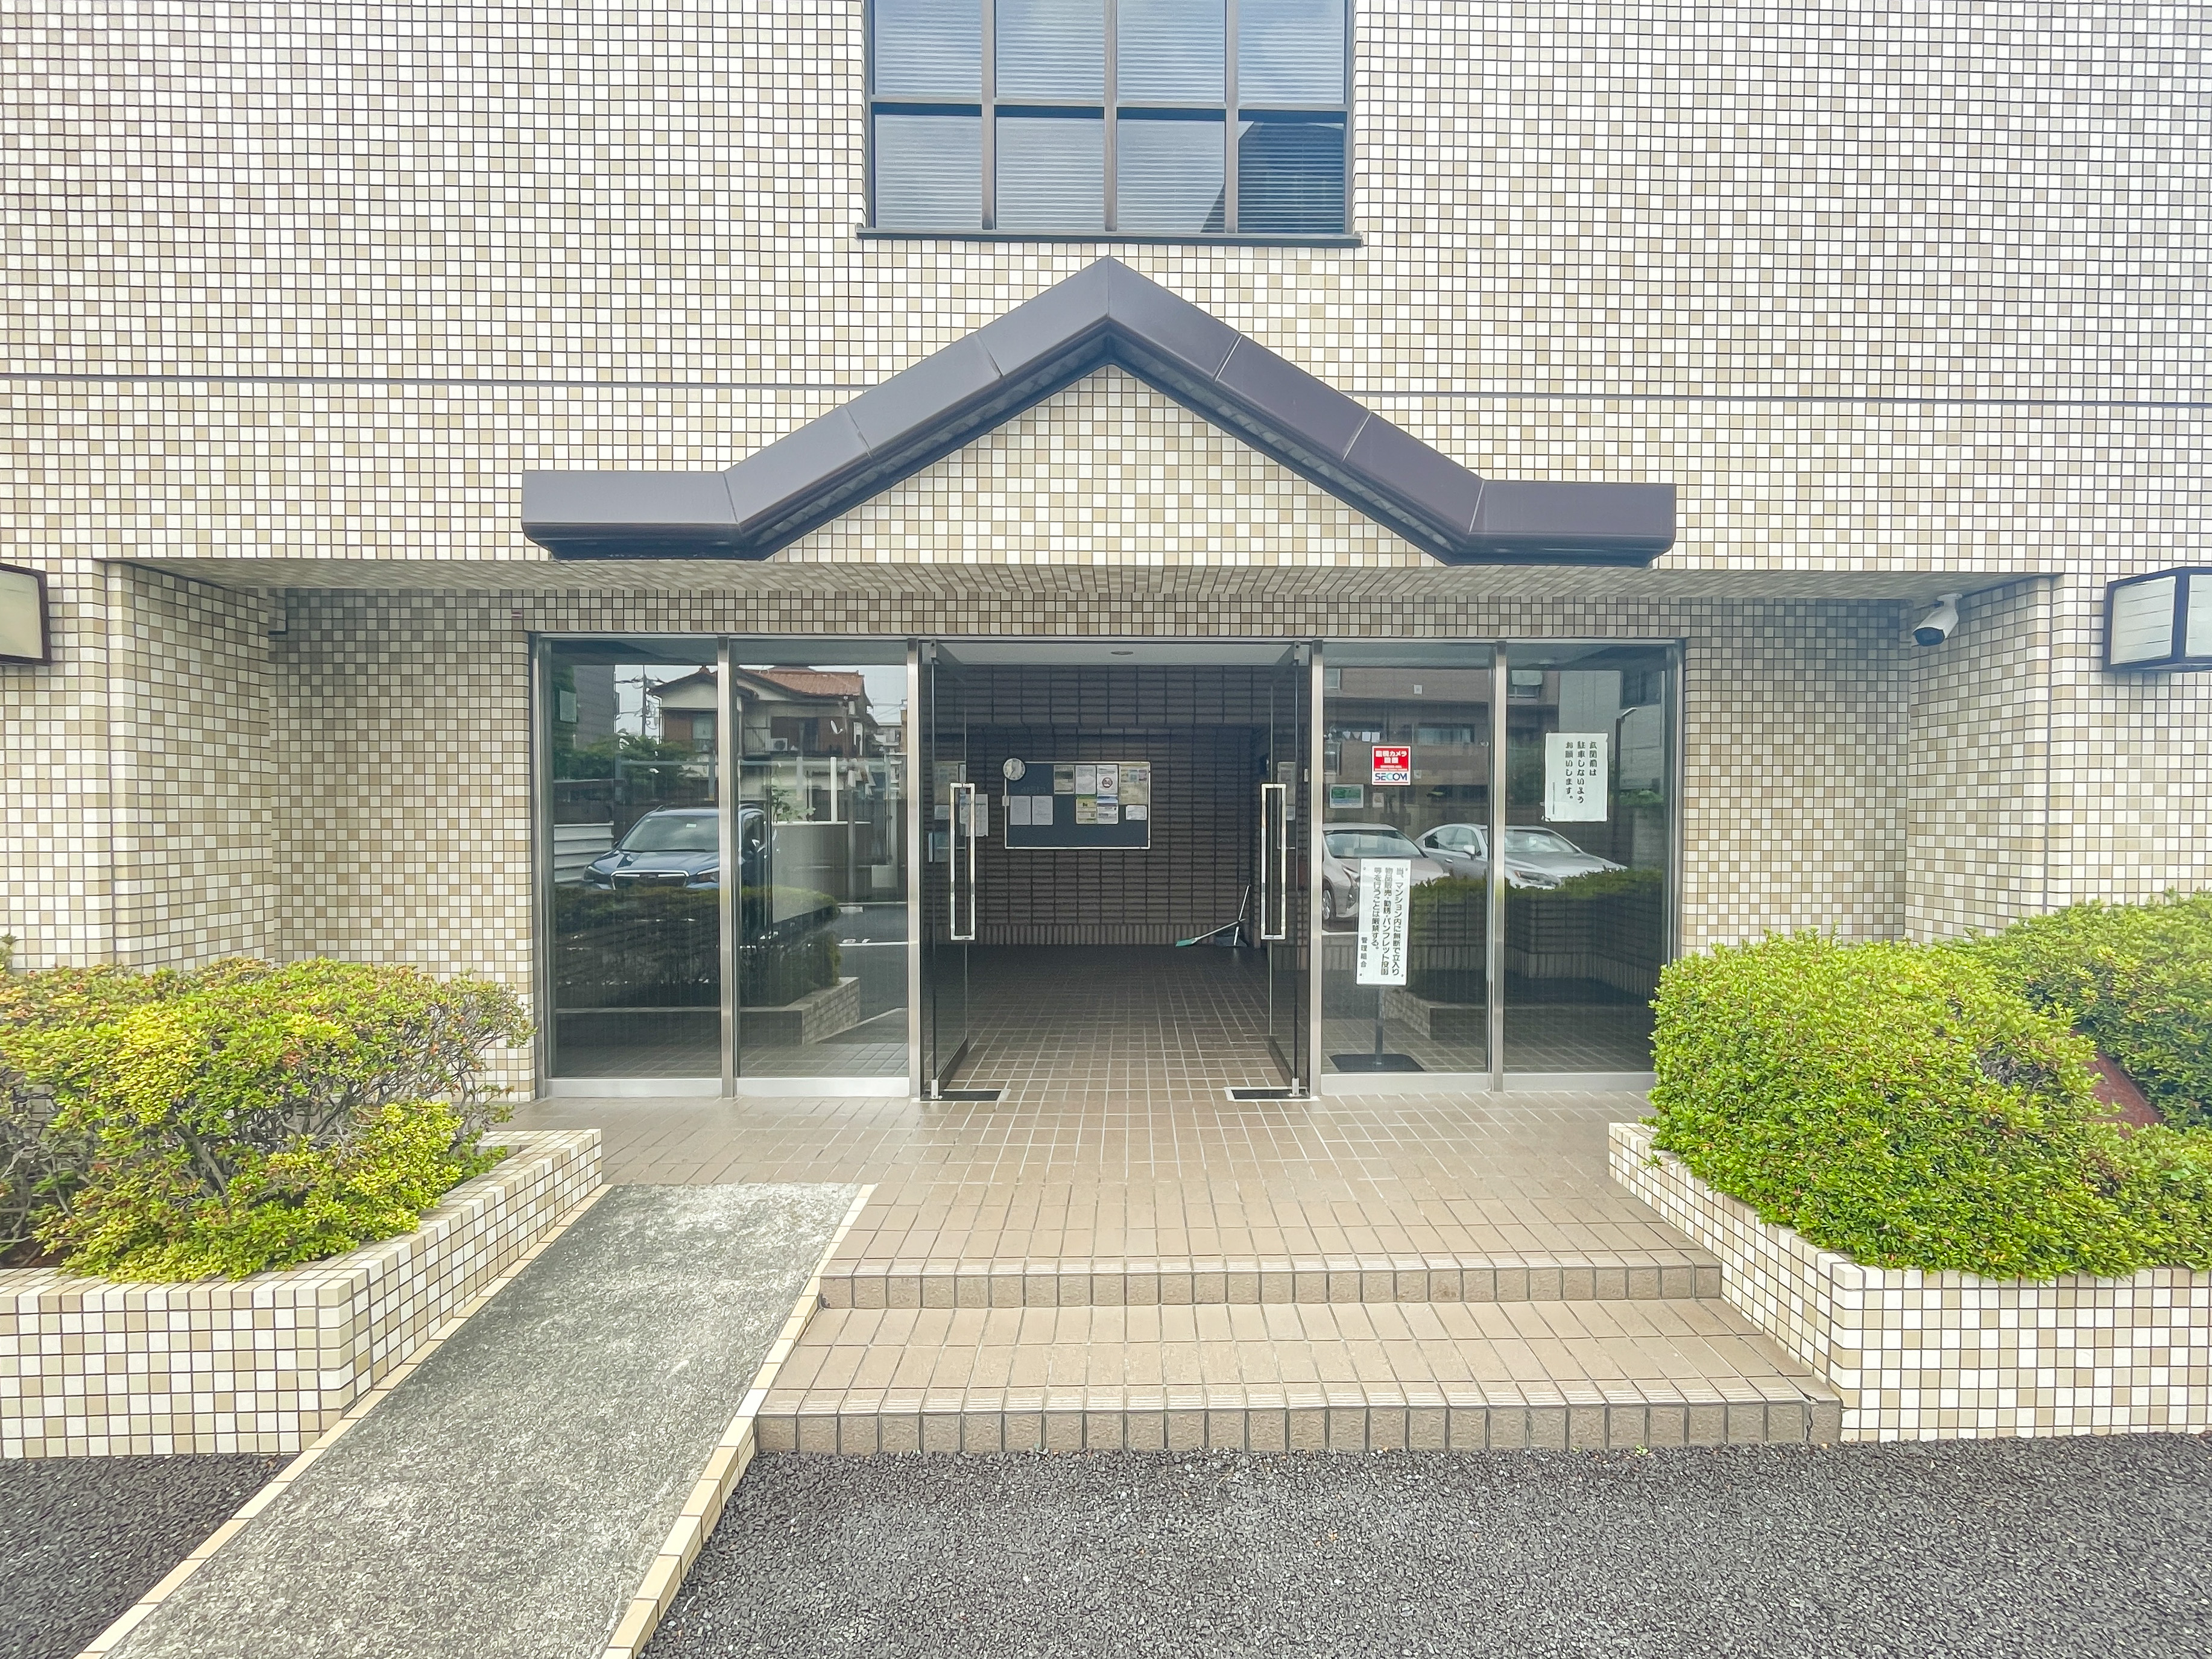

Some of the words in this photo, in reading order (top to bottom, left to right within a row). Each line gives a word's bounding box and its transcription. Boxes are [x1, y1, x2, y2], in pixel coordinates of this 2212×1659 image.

[1375, 773, 1408, 781] SECOM
[1565, 741, 1573, 799] お願いします。
[1577, 741, 1585, 803] 駐車しないよう
